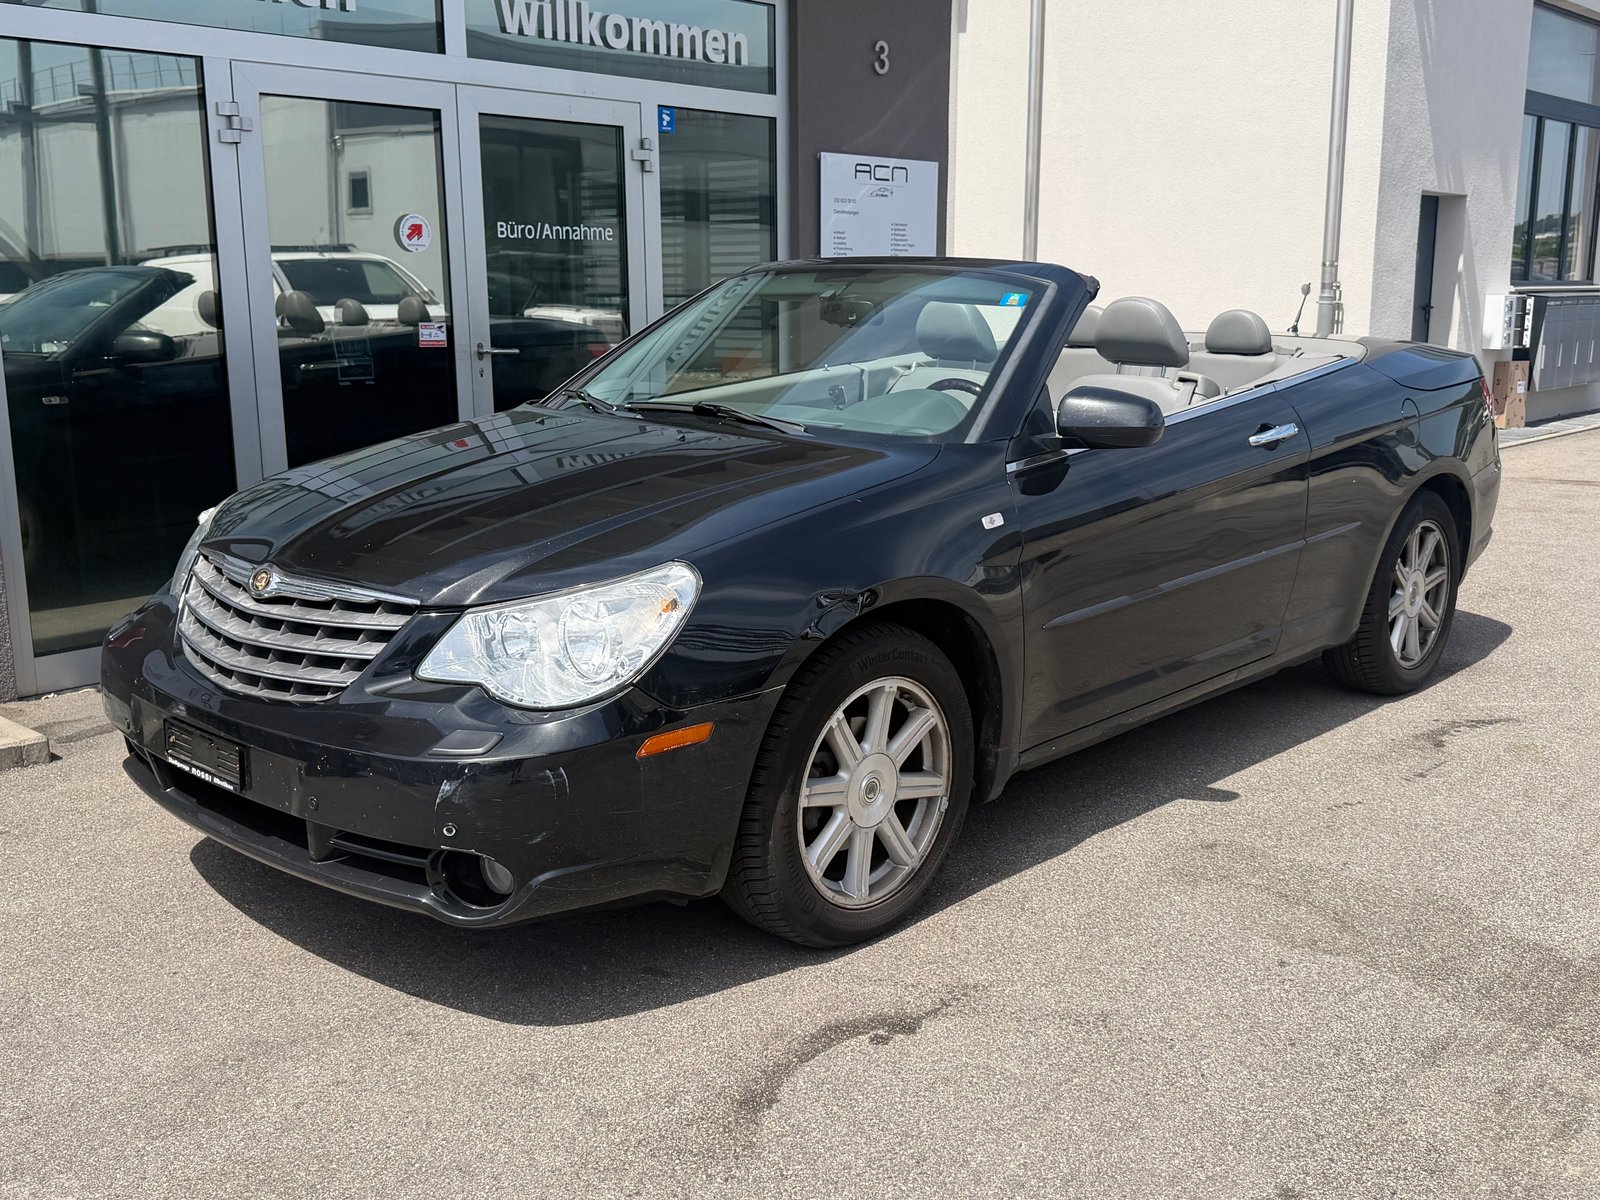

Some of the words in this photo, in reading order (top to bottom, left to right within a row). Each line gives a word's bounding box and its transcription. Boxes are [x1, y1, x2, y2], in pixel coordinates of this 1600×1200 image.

[501, 0, 749, 66] Willkommen
[874, 40, 890, 75] 3
[496, 221, 614, 241] Büro/Annahme
[191, 767, 212, 782] ROSSI
